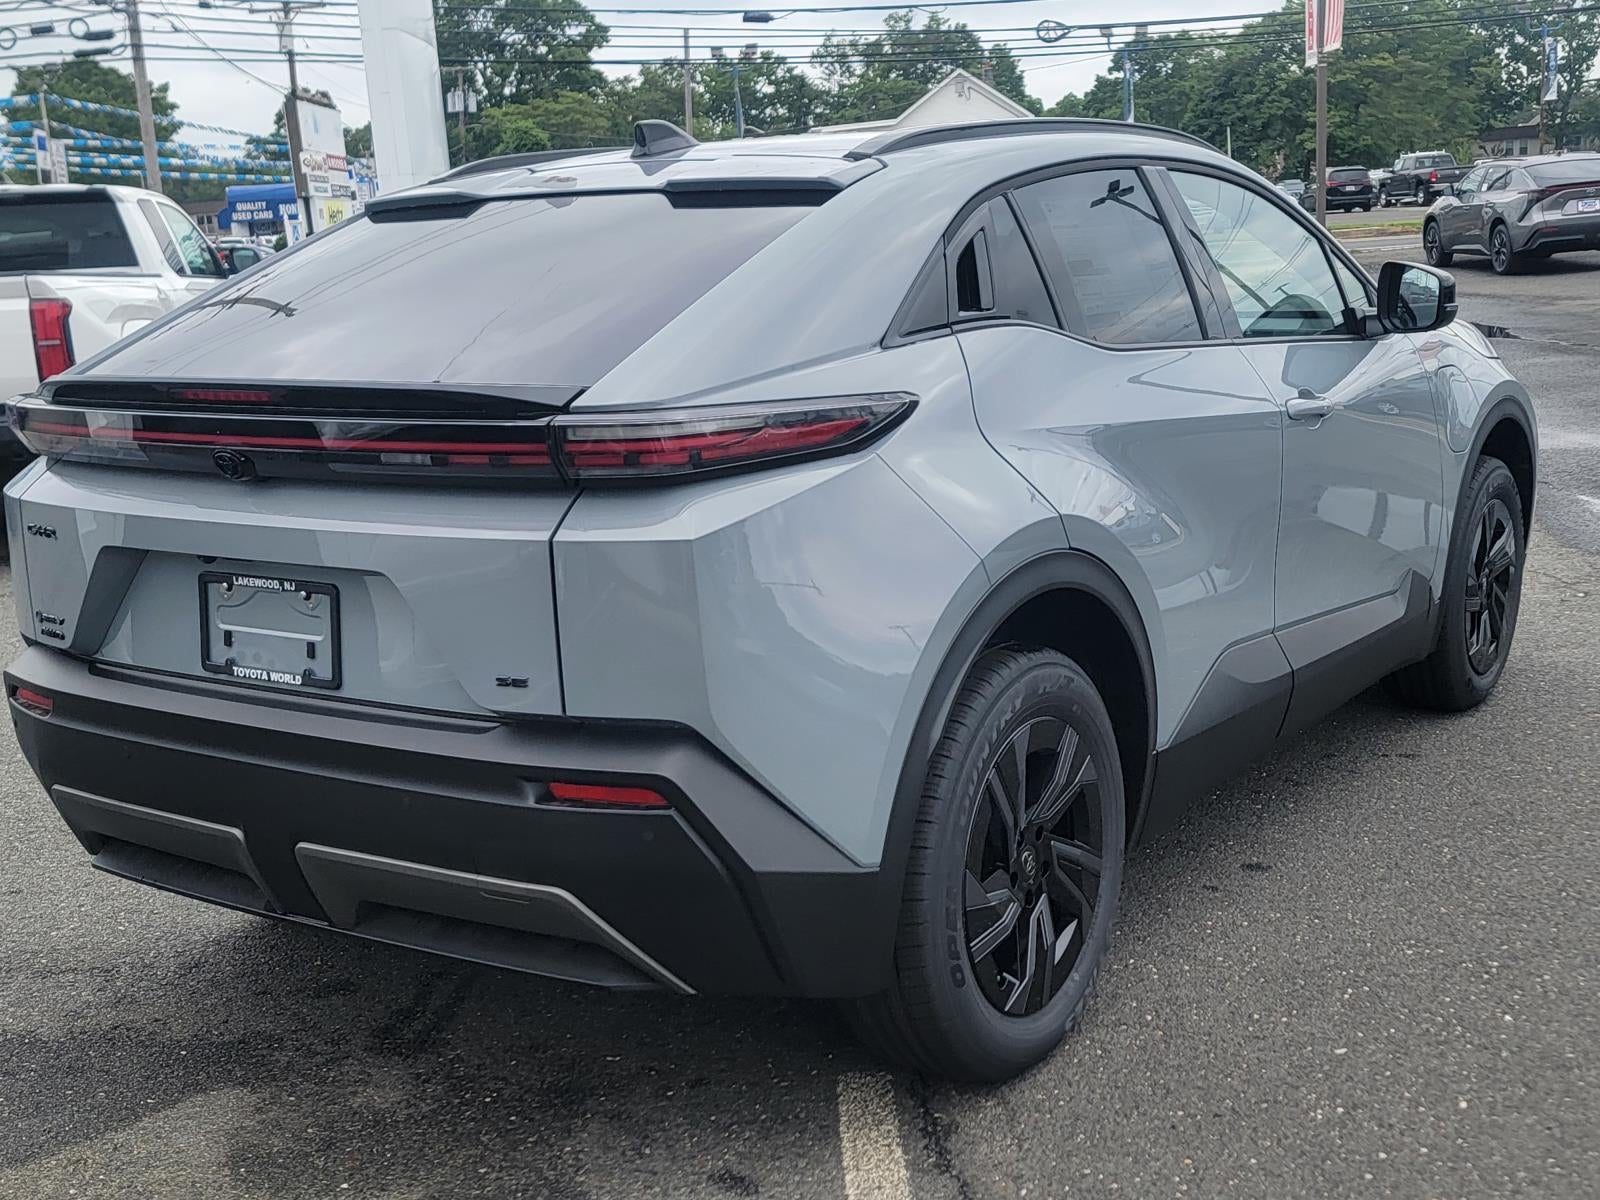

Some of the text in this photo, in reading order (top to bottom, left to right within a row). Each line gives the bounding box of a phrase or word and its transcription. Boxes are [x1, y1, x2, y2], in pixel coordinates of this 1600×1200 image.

[235, 201, 266, 210] QUALITY
[232, 210, 273, 220] USED CARS
[232, 575, 296, 591] LAKEWOOD, NJ
[232, 666, 302, 685] TOYOTA WORLD
[495, 675, 529, 688] SE
